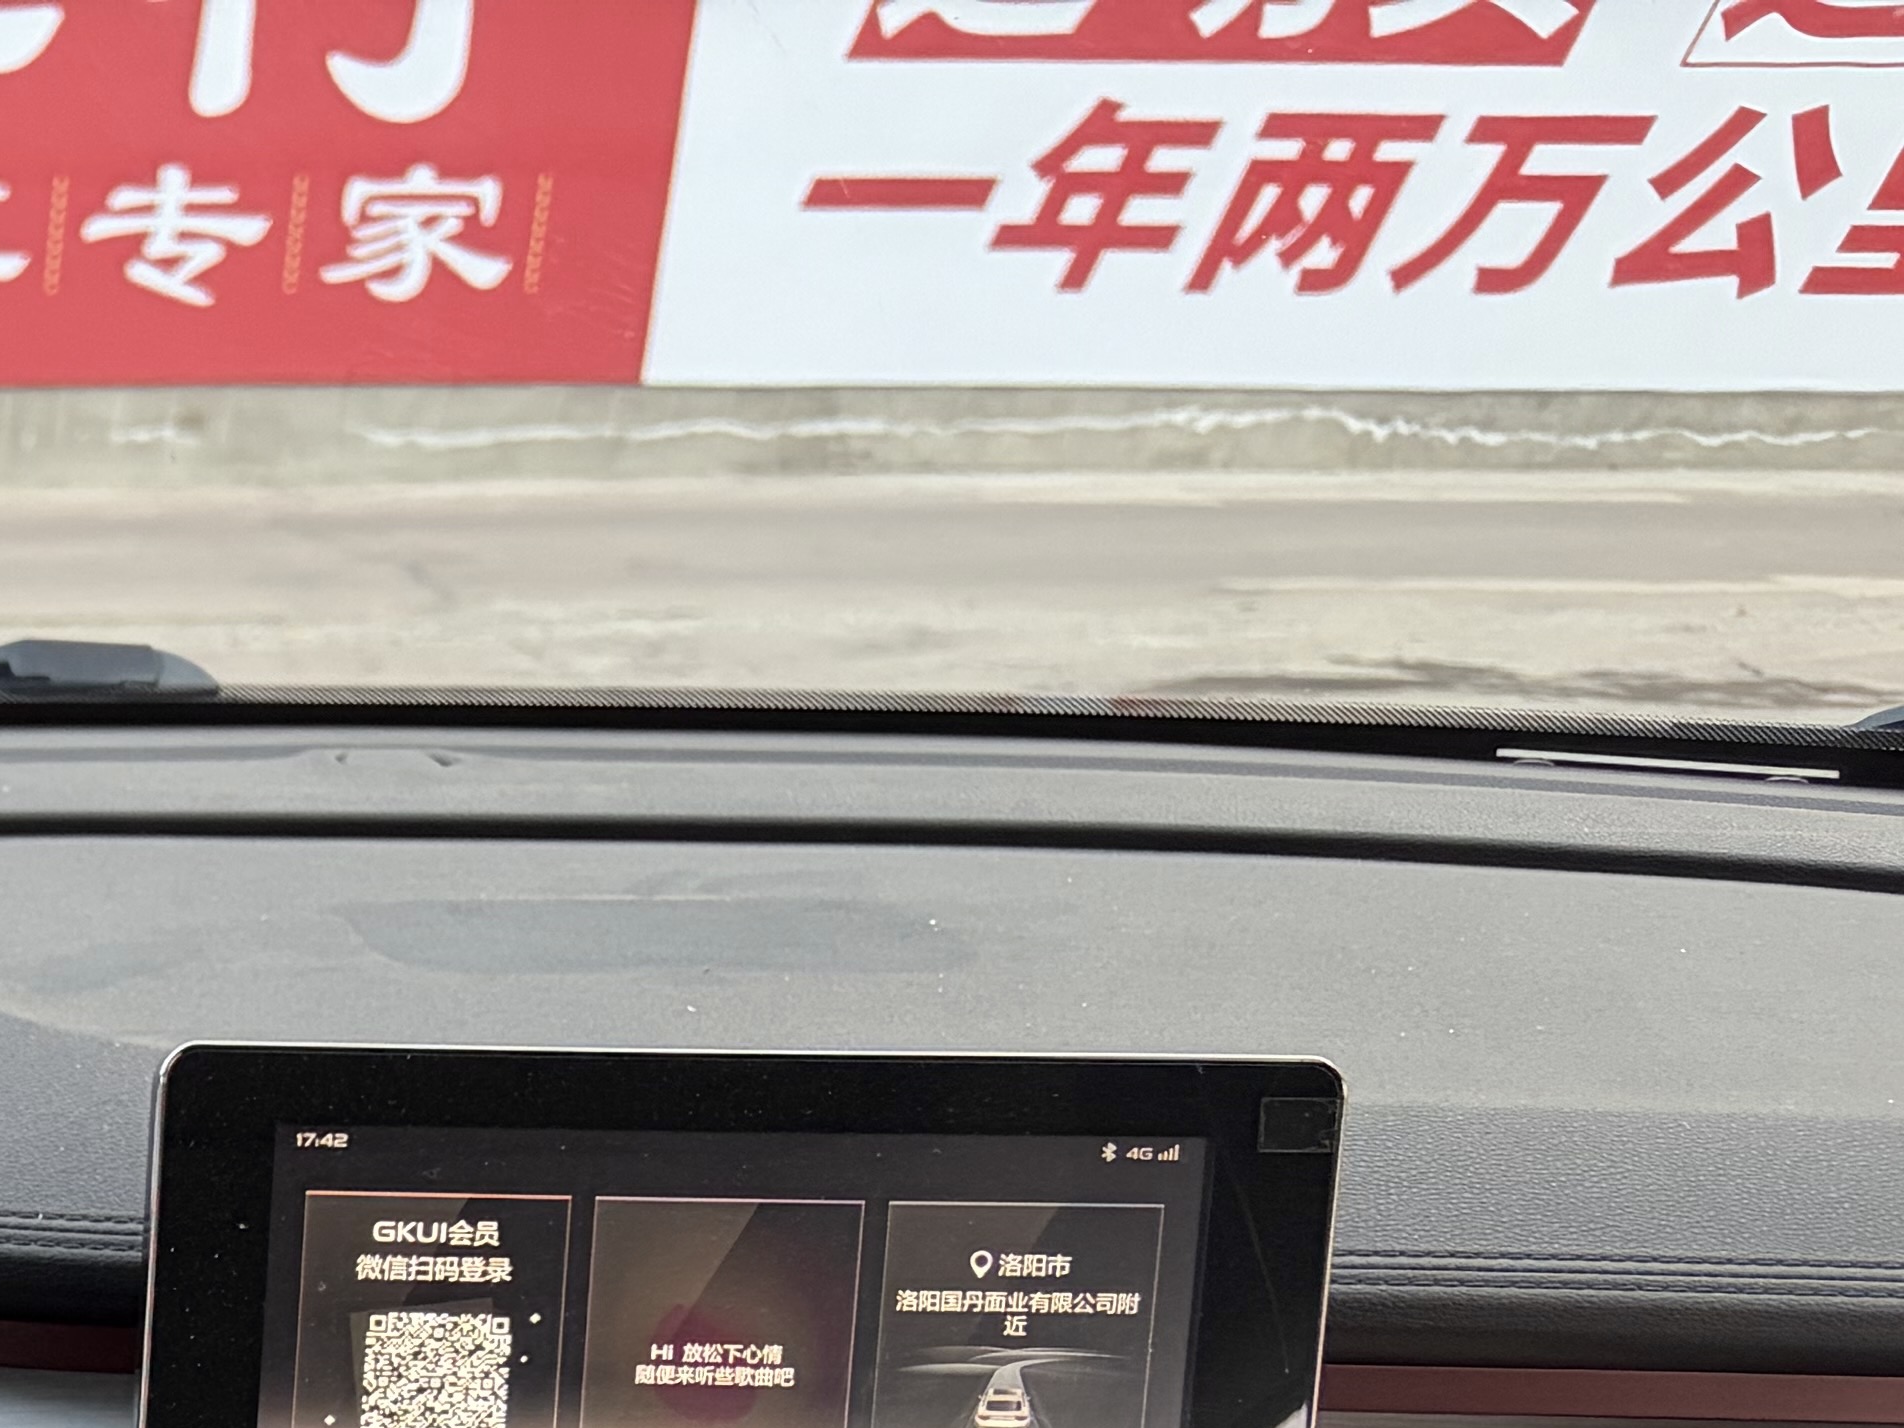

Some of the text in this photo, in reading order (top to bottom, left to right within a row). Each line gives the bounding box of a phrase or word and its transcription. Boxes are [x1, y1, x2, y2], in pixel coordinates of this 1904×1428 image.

[1126, 1146, 1153, 1160] 4G
[372, 1219, 500, 1247] GKUI会员
[355, 1254, 514, 1283] 微信扫码登录
[997, 1253, 1072, 1278] 洛阳市
[1003, 1315, 1027, 1337] 近
[650, 1343, 783, 1364] Hi 放松下心情
[634, 1364, 795, 1387] 随便来听些歌曲吧
